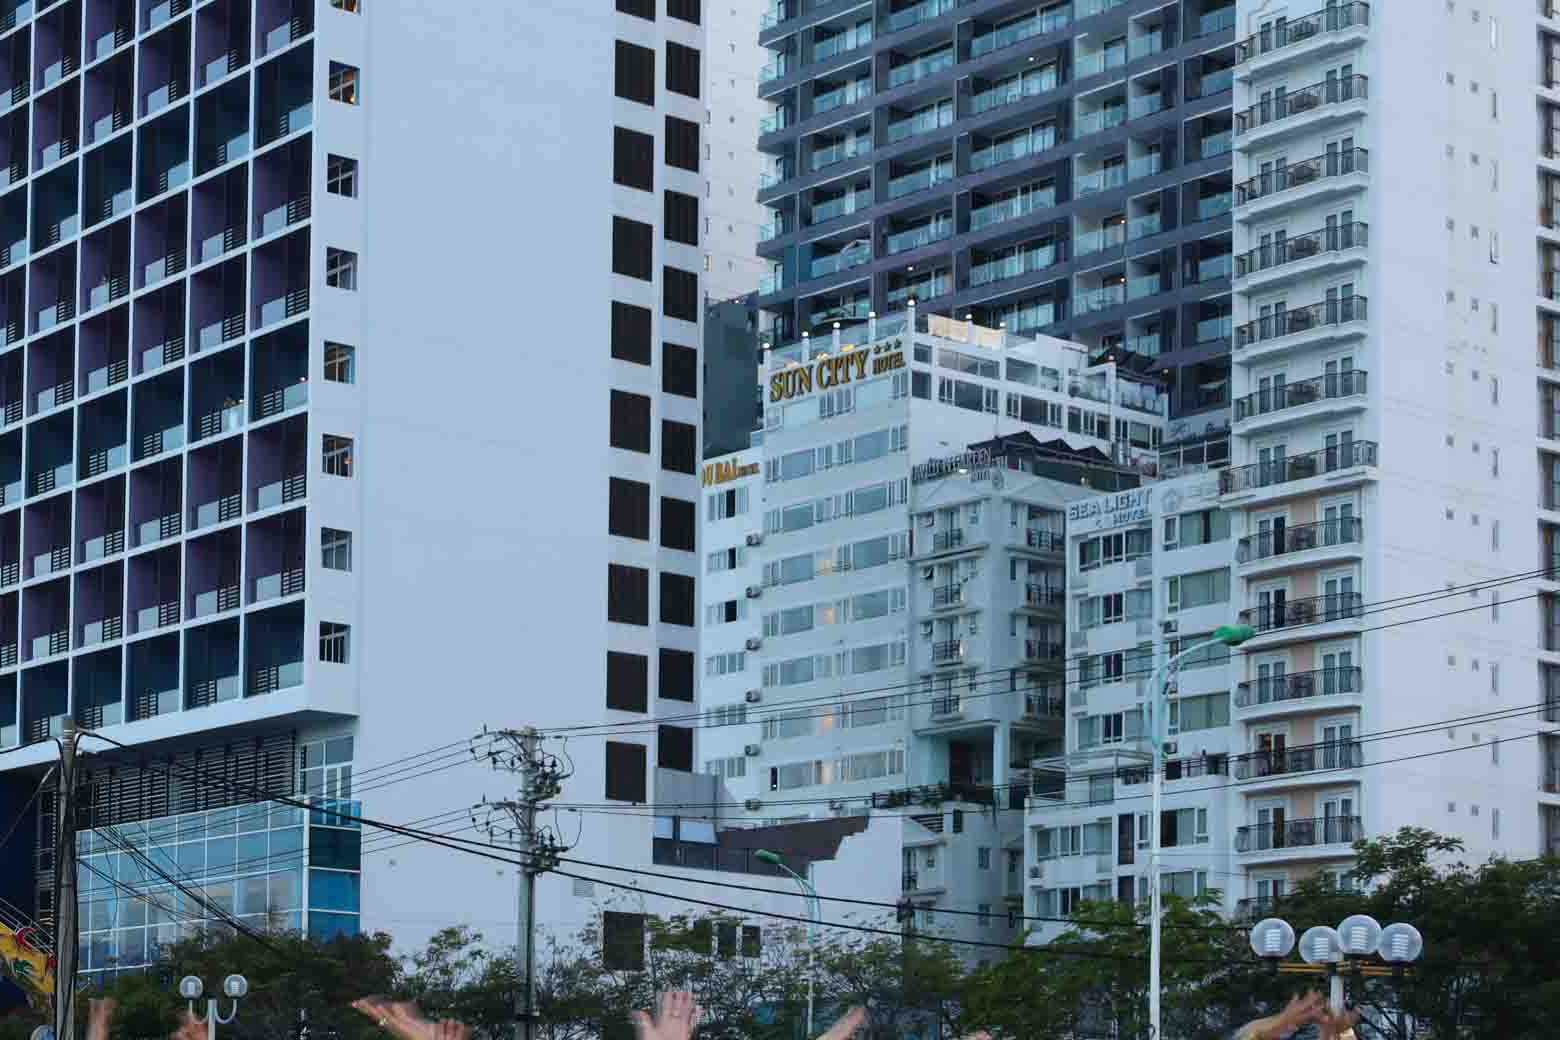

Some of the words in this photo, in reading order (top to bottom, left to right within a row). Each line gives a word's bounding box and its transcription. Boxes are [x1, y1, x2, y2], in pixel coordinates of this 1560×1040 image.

[769, 364, 813, 402] SUN
[816, 348, 870, 390] CITY
[1069, 501, 1102, 520] SEA
